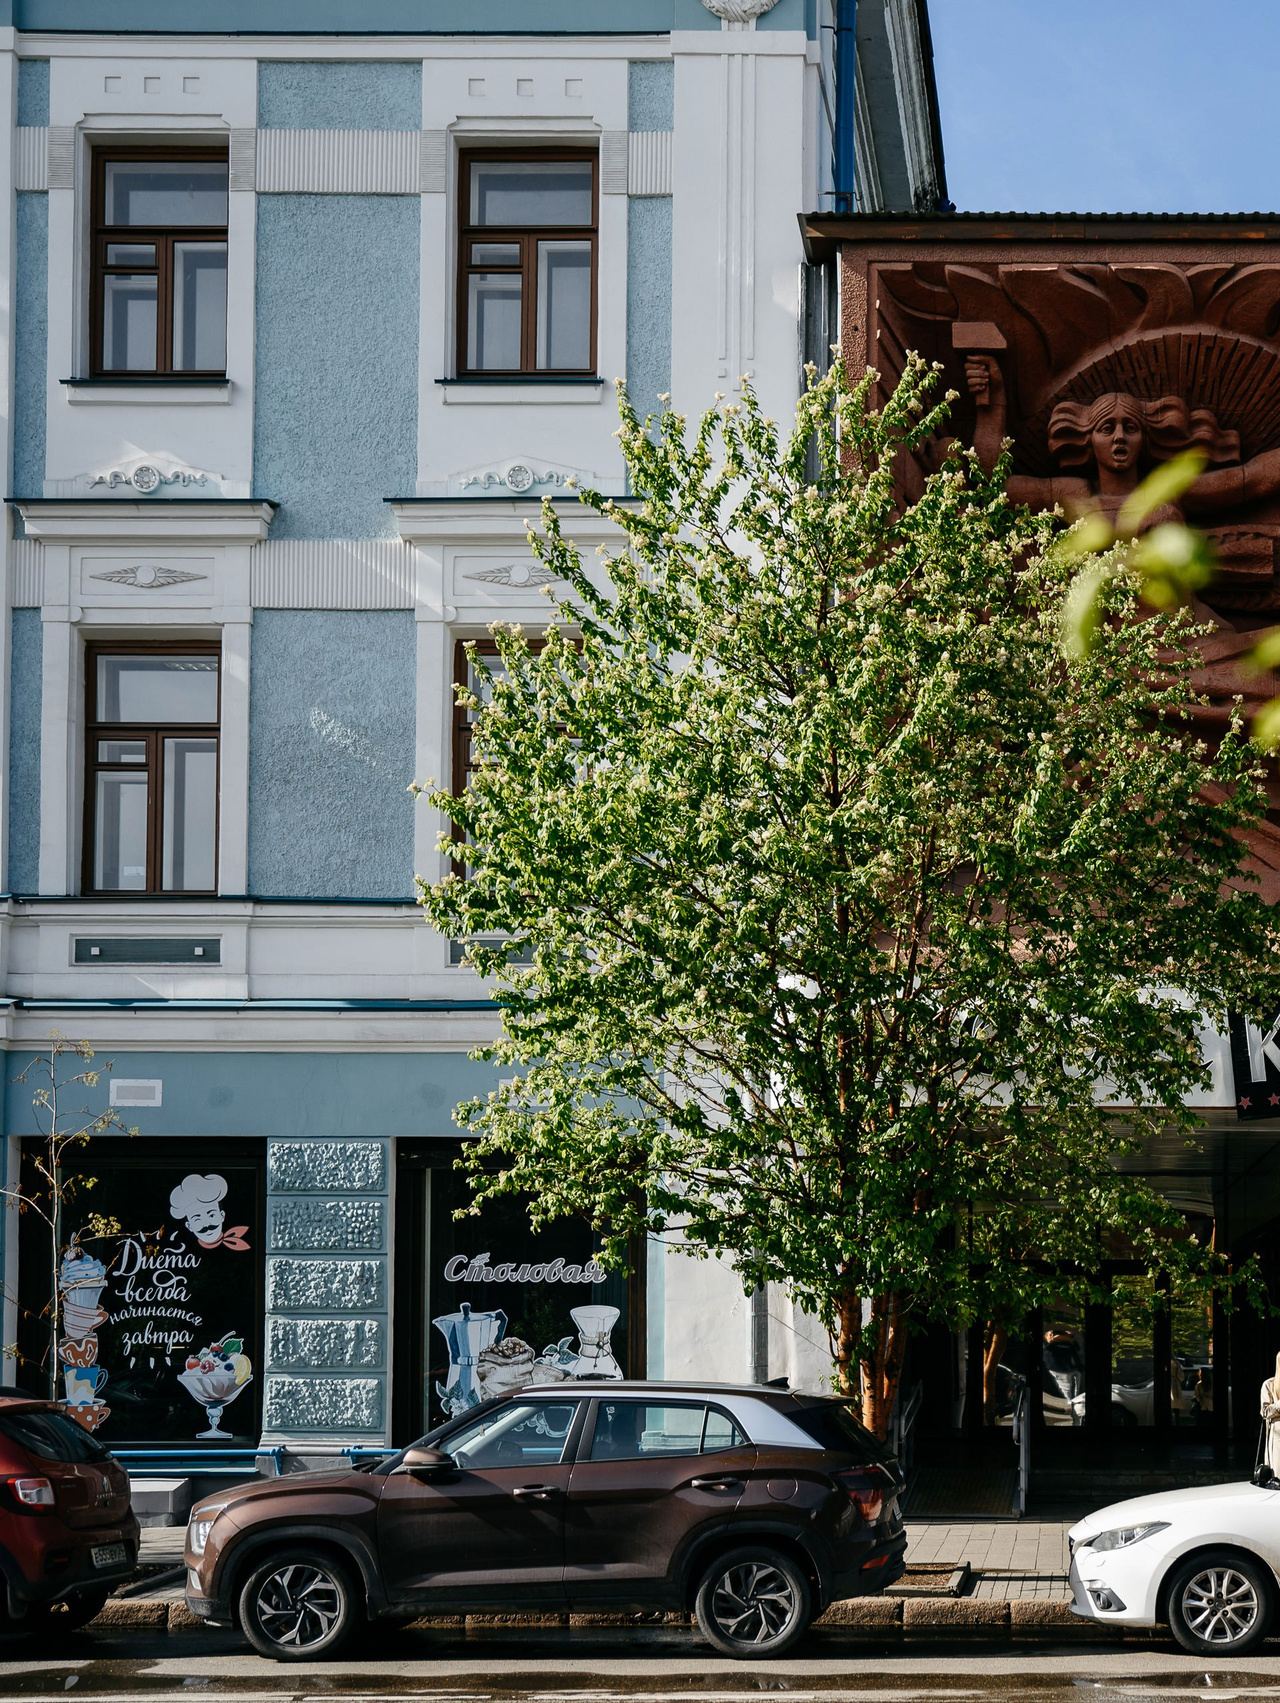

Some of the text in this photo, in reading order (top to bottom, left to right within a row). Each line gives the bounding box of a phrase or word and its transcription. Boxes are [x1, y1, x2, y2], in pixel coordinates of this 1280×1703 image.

[112, 1238, 202, 1276] Диета
[444, 1253, 607, 1284] Столовая
[115, 1269, 192, 1302] всегда
[109, 1304, 203, 1326] начинается
[121, 1320, 194, 1356] завтра
